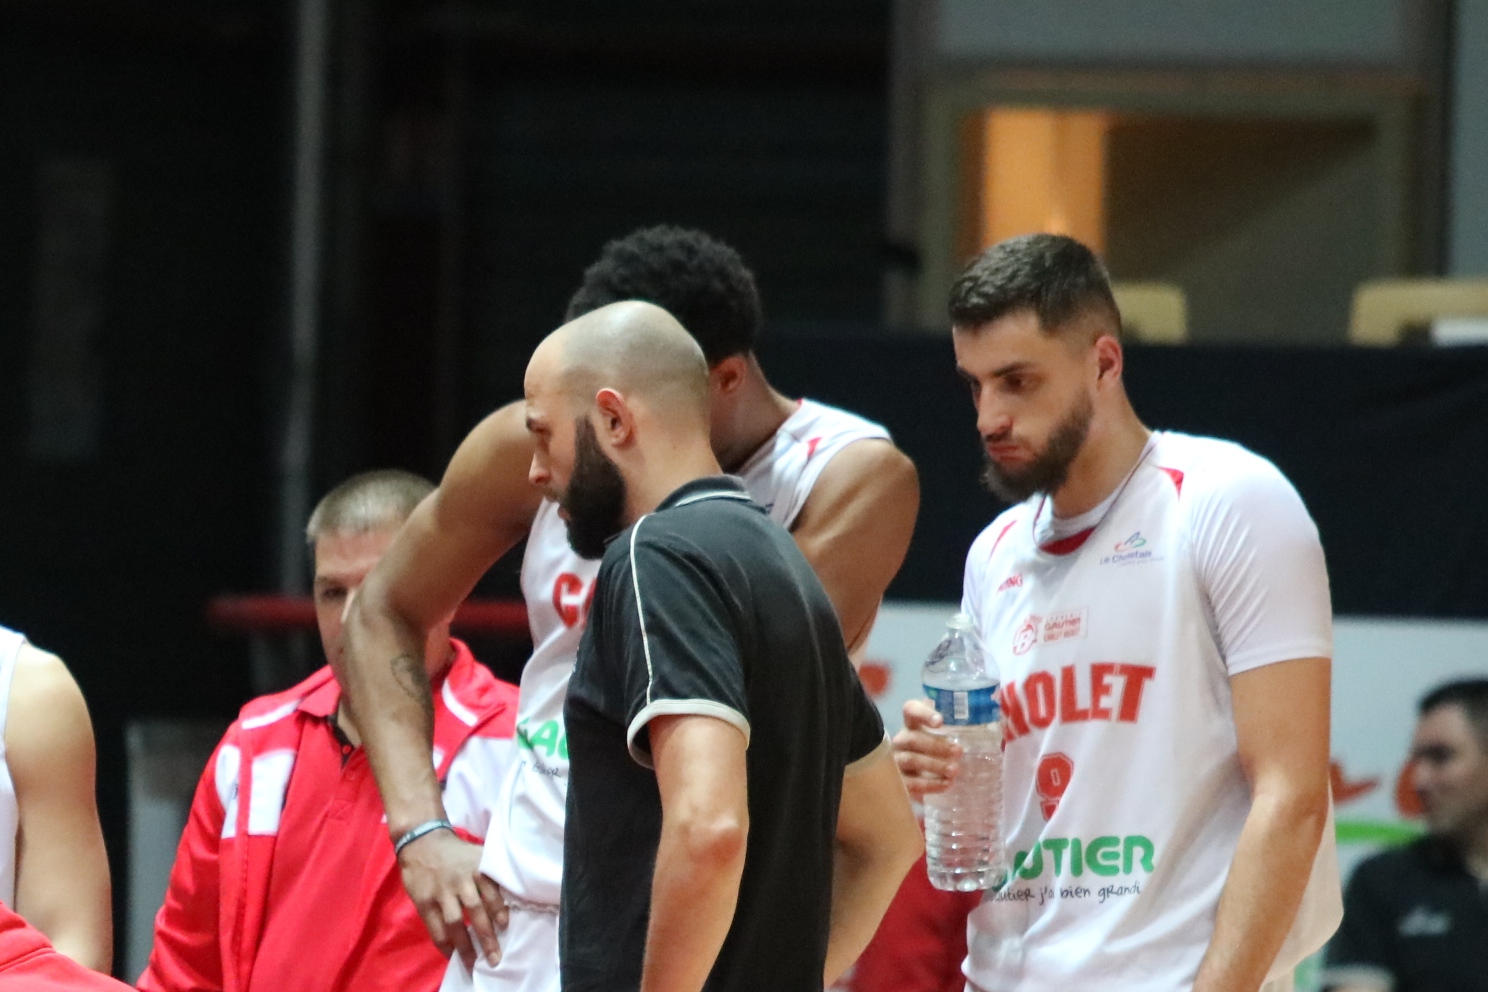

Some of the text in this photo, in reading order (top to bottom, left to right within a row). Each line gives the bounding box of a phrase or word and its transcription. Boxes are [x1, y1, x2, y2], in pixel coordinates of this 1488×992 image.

[1000, 662, 1157, 744] HOLET
[1036, 752, 1075, 823] 9
[994, 835, 1155, 891] UTIER
[1060, 882, 1092, 900] bien
